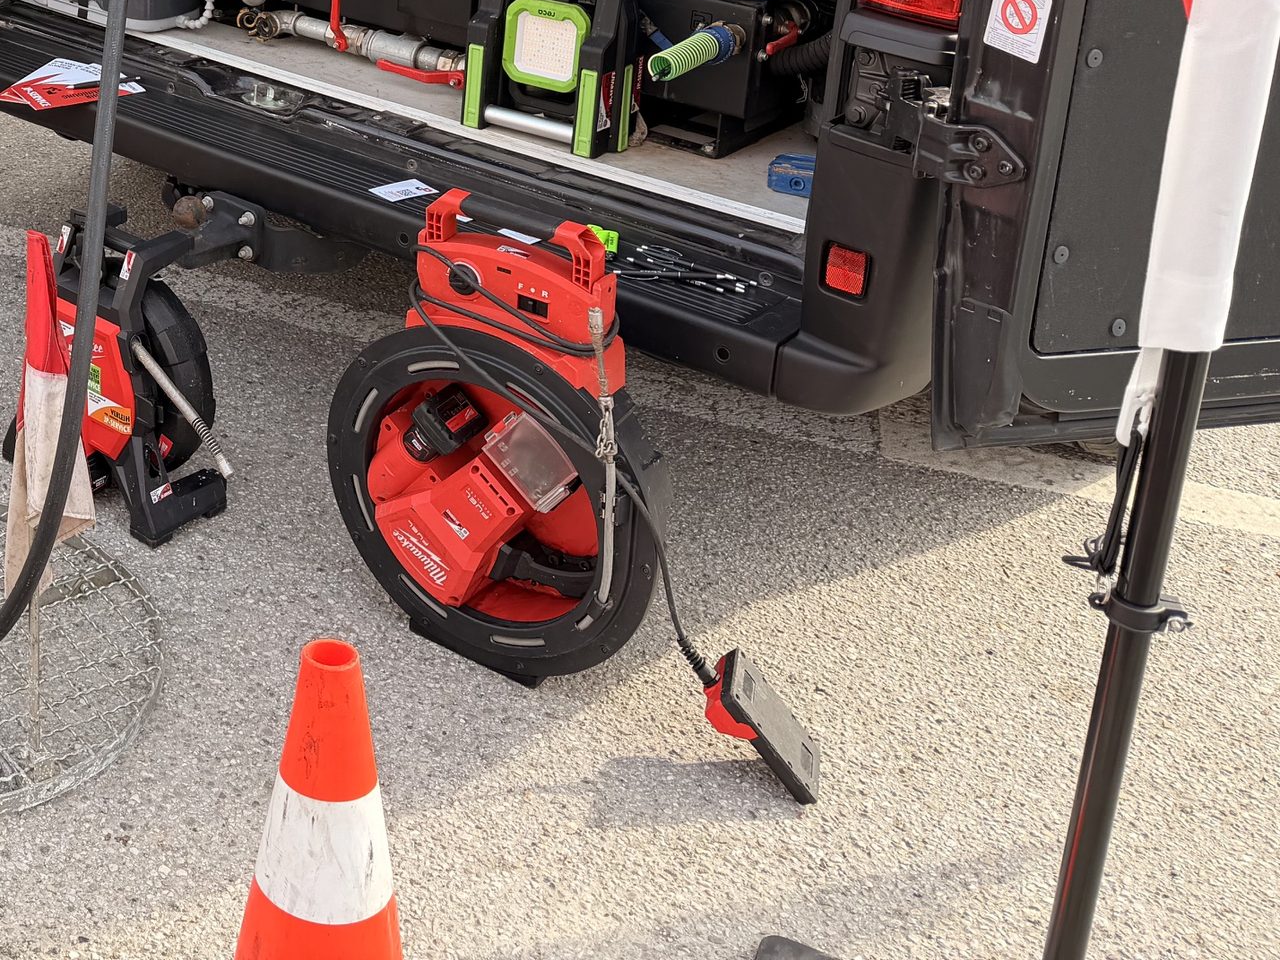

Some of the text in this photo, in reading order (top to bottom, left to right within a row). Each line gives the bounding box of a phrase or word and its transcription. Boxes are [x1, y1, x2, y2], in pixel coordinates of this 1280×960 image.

[518, 282, 549, 298] F R
[110, 408, 130, 422] VERLEIH
[104, 417, 132, 433] JP-SERVICE
[393, 529, 448, 586] Milwaukee
